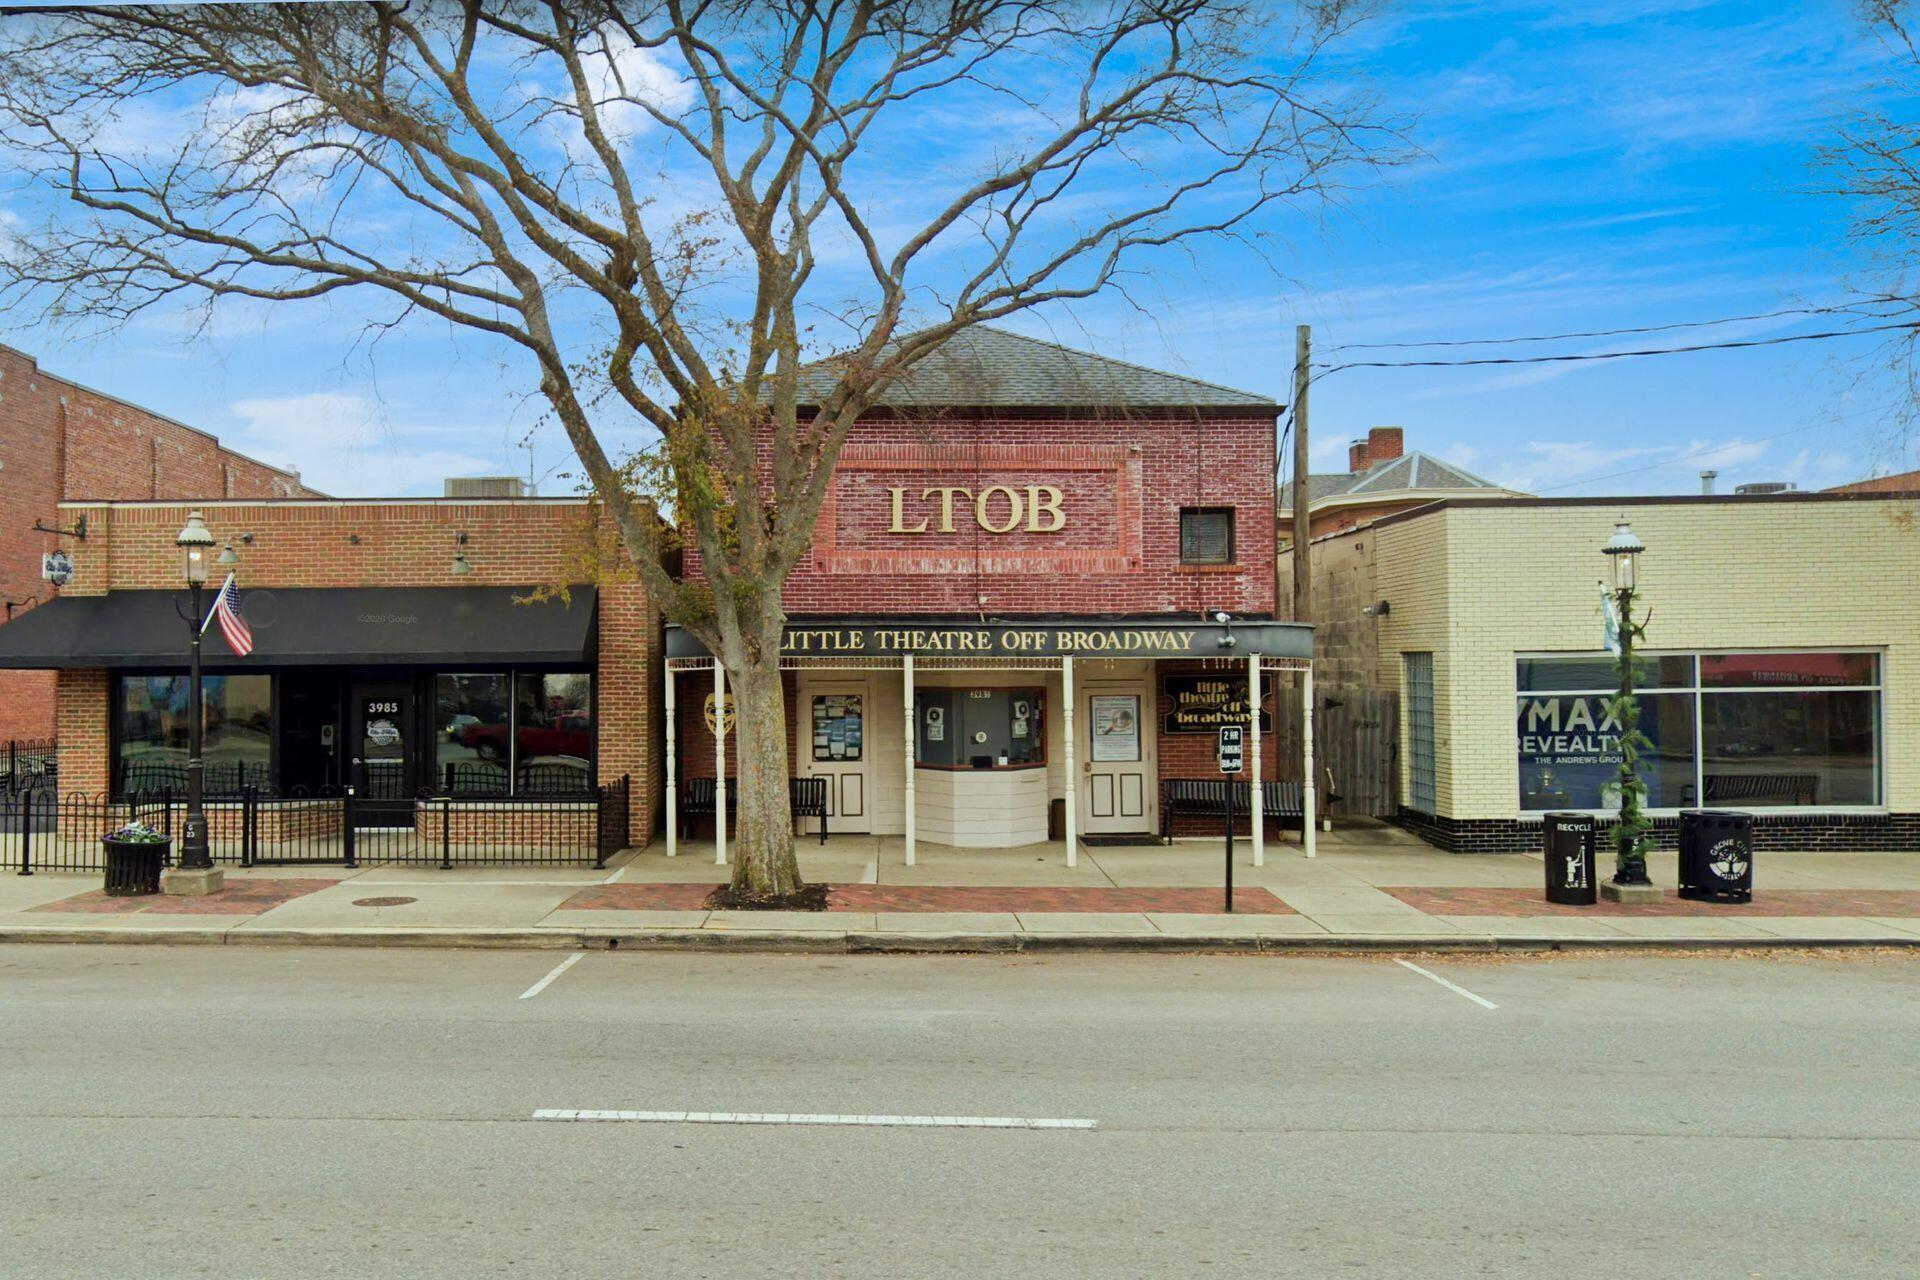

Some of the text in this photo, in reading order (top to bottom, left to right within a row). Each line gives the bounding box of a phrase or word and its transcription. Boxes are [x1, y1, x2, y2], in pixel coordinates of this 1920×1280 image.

[887, 485, 1066, 533] LTOB
[780, 631, 1195, 650] ITTLE THEATRE OFF BROADWAY
[1197, 682, 1229, 692] little
[1180, 692, 1229, 704] theatre
[369, 702, 398, 713] 3985
[1222, 702, 1240, 712] off
[1176, 712, 1252, 723] broadway
[1223, 731, 1240, 740] 2 HR
[1517, 735, 1623, 753] EVEALTY
[1222, 745, 1241, 754] PARKING
[1535, 757, 1553, 765] THE
[1556, 756, 1598, 765] ANDREWS
[1557, 823, 1592, 832] RECYCLE
